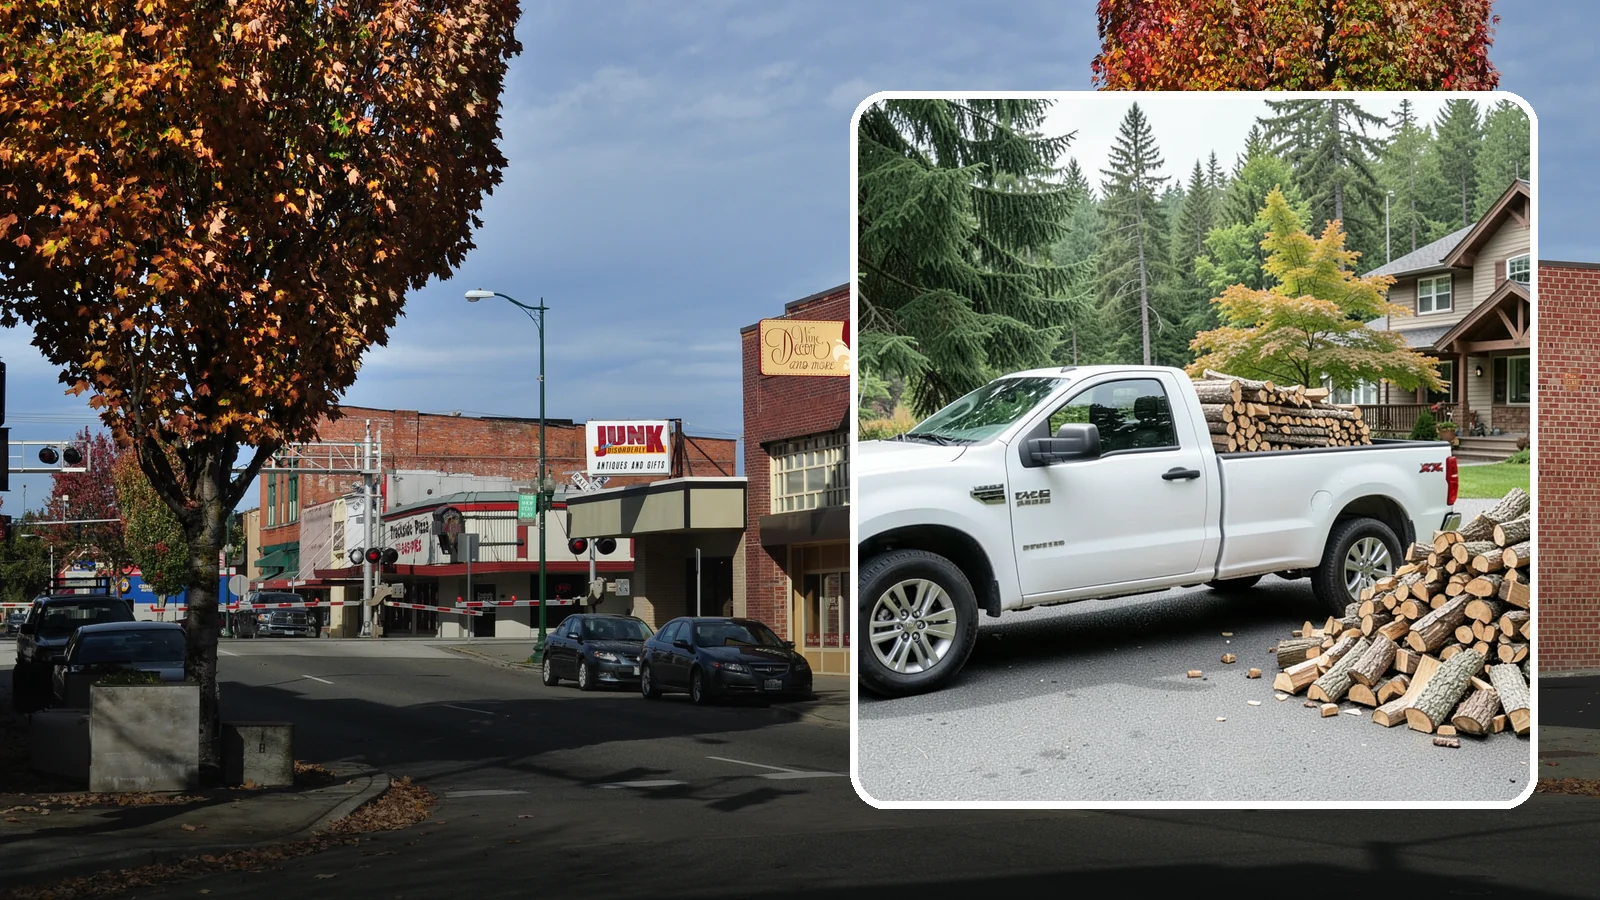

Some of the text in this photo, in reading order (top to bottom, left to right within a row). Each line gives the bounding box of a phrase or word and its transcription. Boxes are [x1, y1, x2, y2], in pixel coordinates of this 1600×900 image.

[765, 327, 831, 365] Decor
[595, 425, 665, 457] JUNK
[607, 446, 646, 454] DISORDERLY
[596, 460, 665, 470] ANTIQUES AND GIFTS
[390, 519, 429, 540] Trackside Pizza
